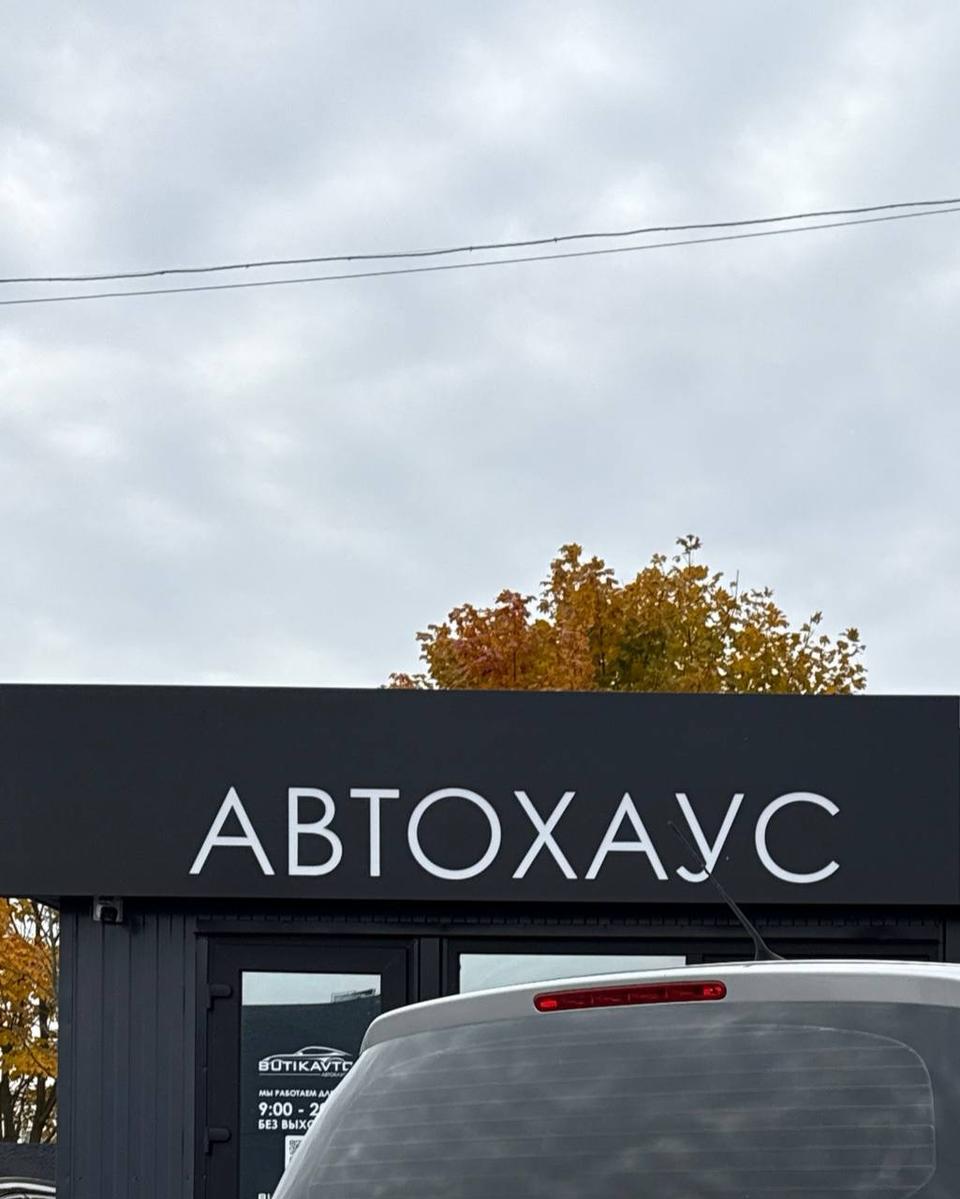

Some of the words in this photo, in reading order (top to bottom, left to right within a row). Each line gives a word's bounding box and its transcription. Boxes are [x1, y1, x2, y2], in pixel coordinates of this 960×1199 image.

[189, 785, 841, 884] АВТОХАУС
[258, 1089, 273, 1097] МЫ
[275, 1089, 317, 1098] РАБОТАЕМ
[258, 1102, 293, 1117] 9:00
[258, 1119, 278, 1130] БЕЗ
